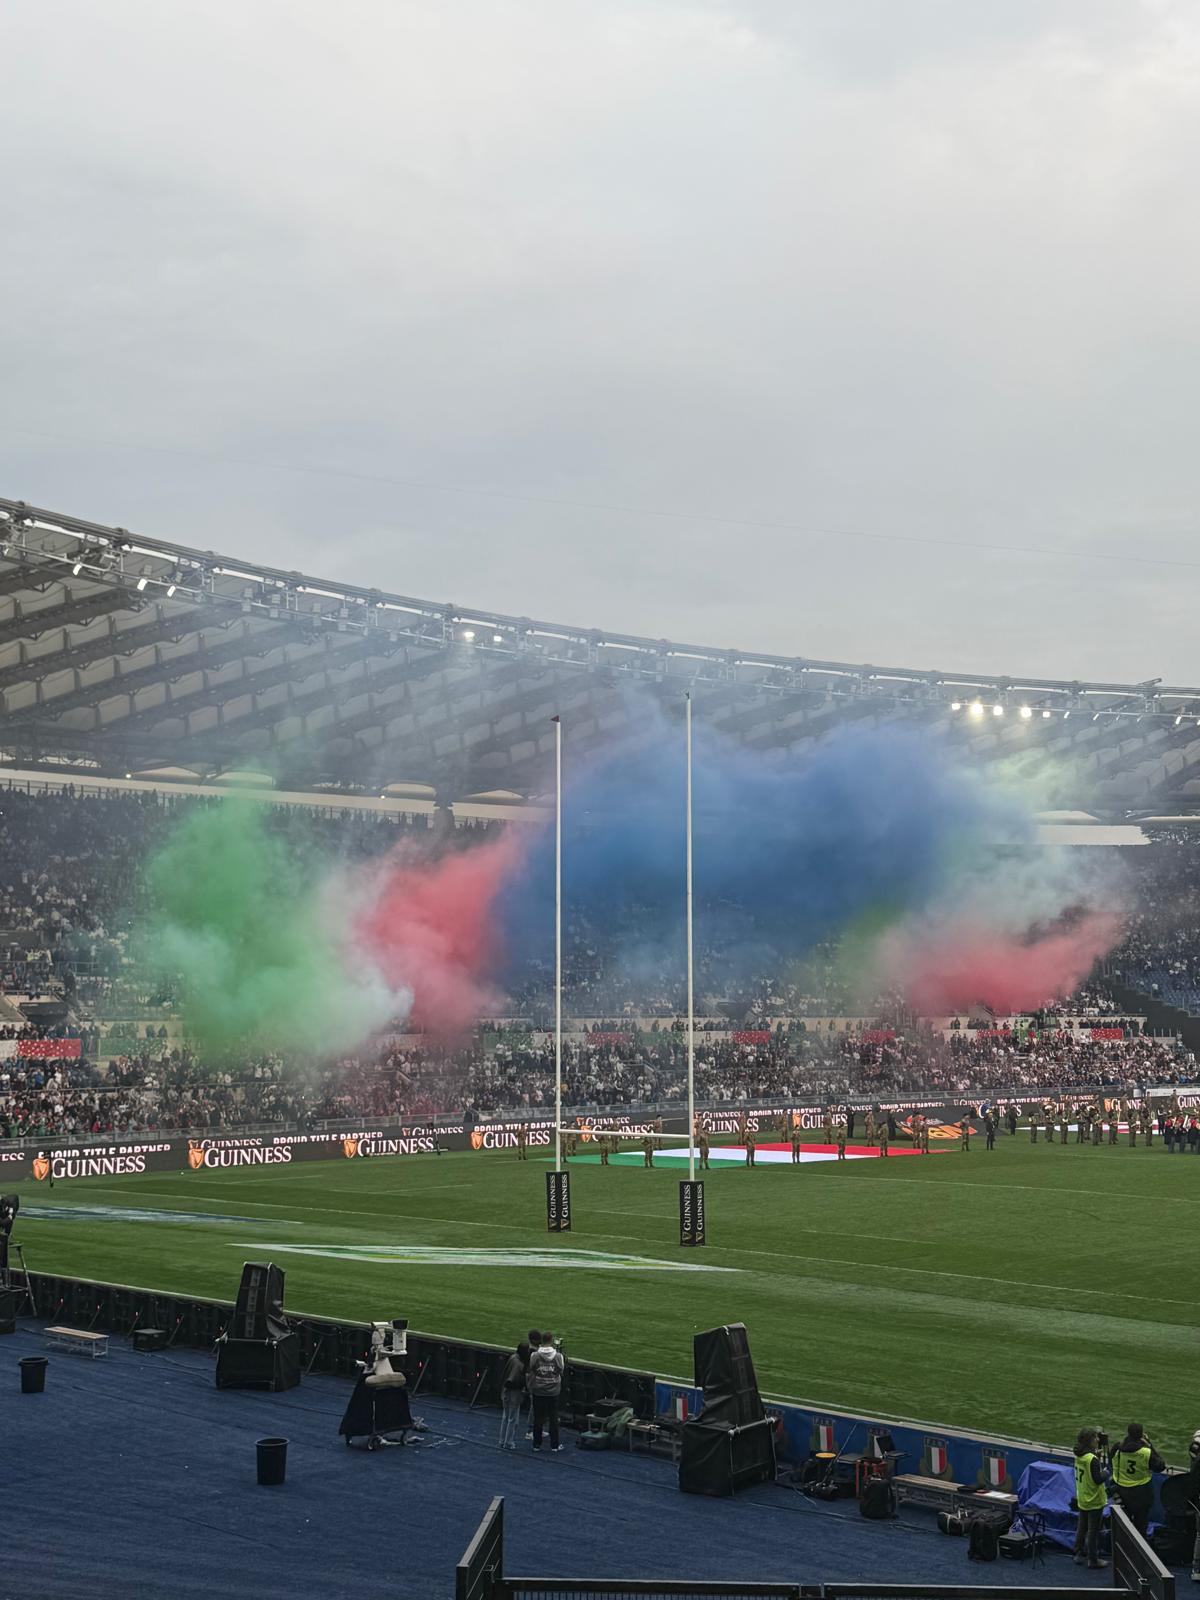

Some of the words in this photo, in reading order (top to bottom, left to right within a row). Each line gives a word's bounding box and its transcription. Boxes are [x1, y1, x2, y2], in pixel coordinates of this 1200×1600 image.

[773, 1108, 791, 1116] TITE
[530, 1120, 567, 1130] PARTNR
[702, 1118, 759, 1133] GUINNSS
[357, 1137, 436, 1157] GUINNESS
[204, 1146, 292, 1168] GUINNESS
[52, 1155, 146, 1179] GUINNESS
[683, 1184, 692, 1231] GUINNESS
[1126, 1460, 1136, 1474] 3
